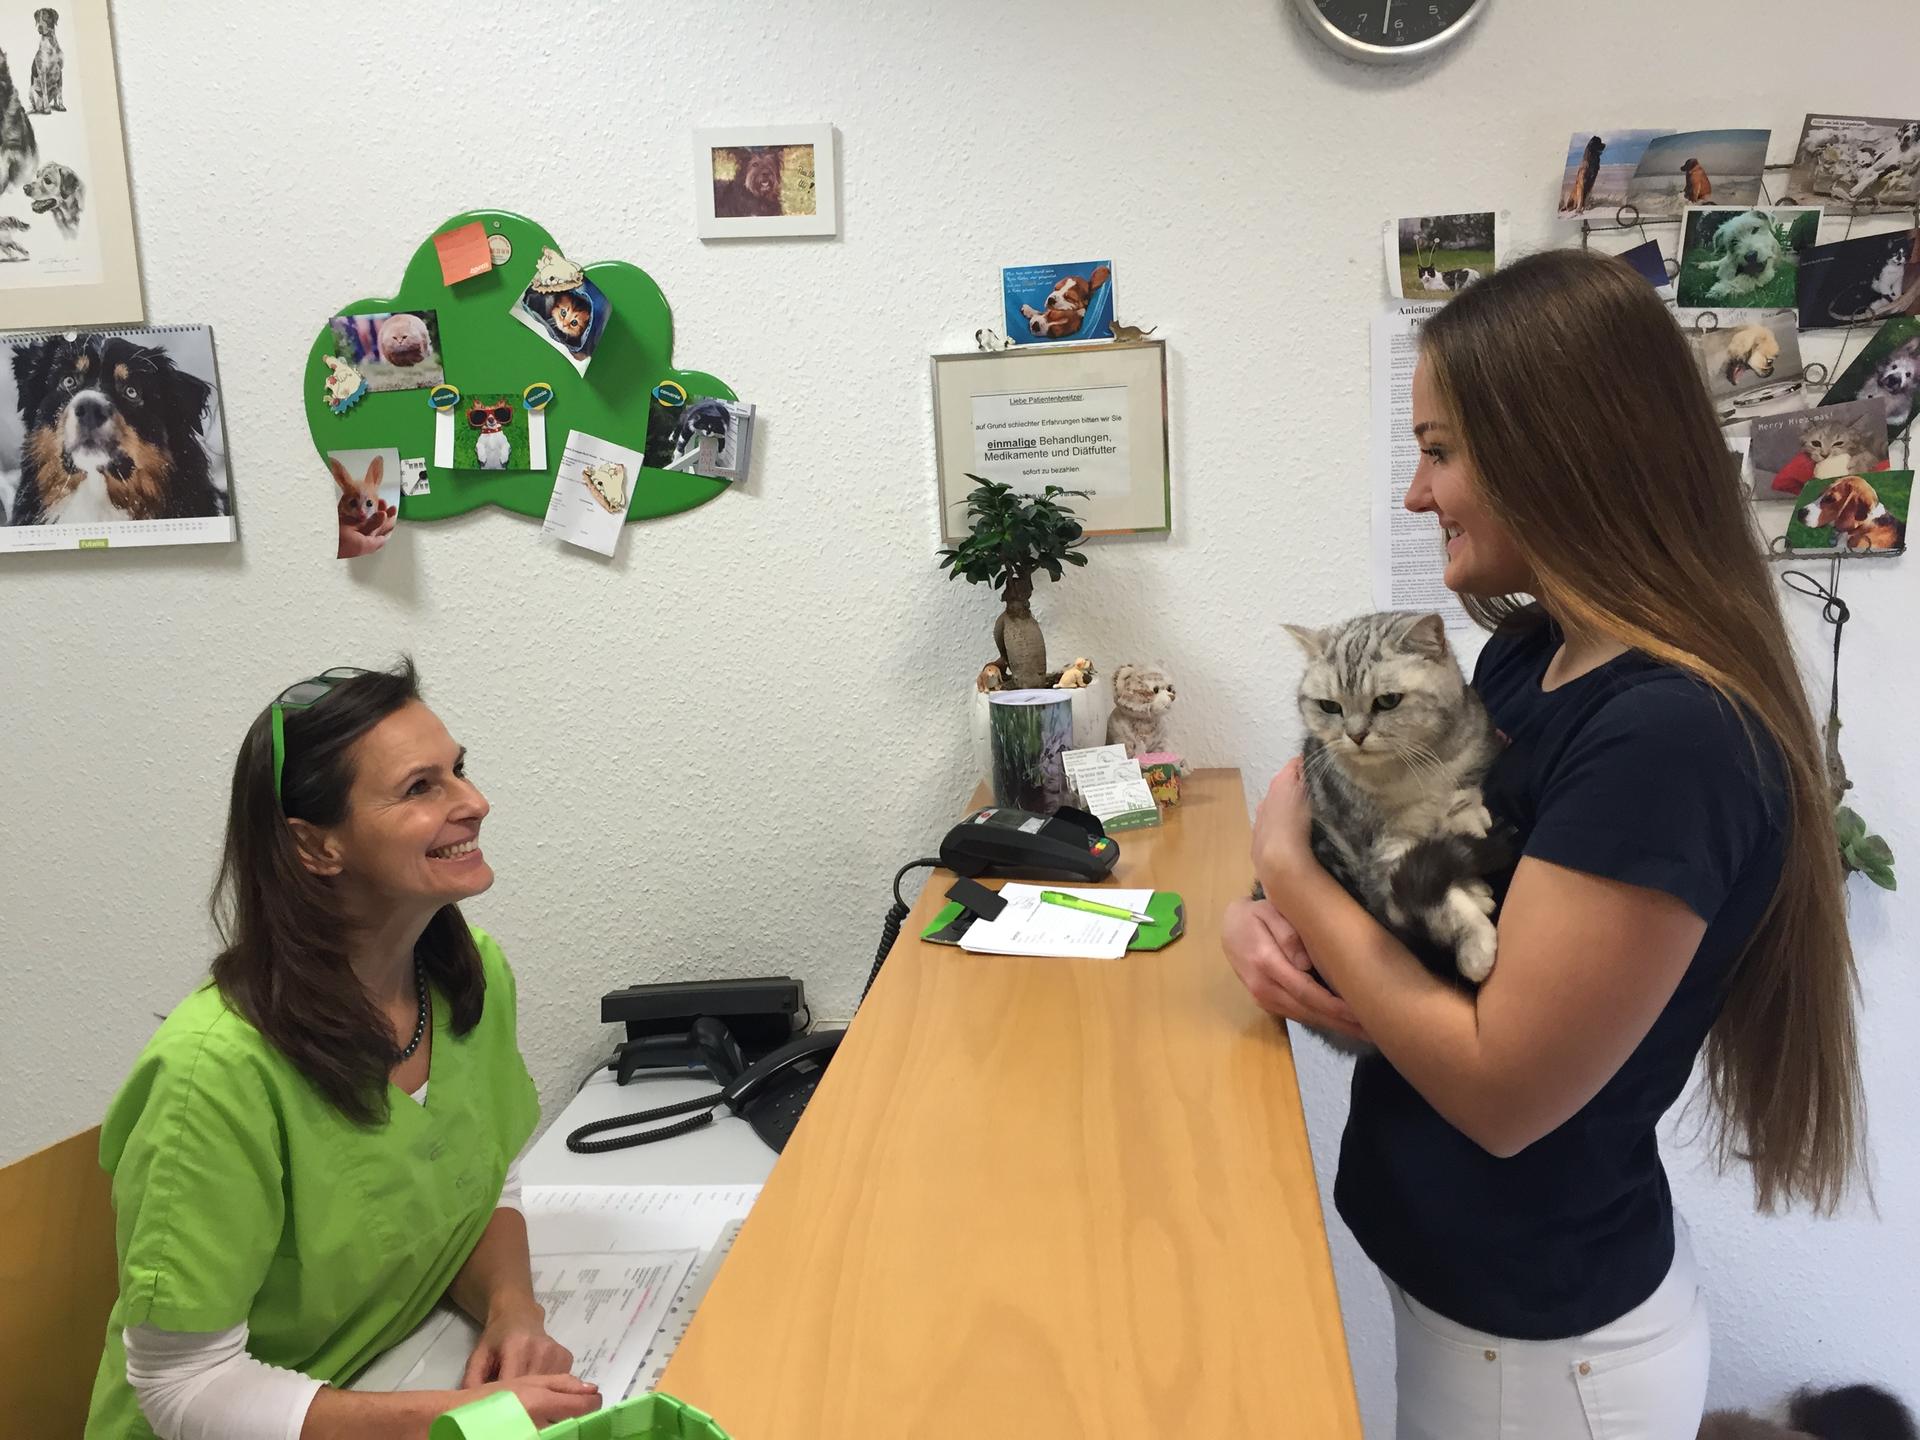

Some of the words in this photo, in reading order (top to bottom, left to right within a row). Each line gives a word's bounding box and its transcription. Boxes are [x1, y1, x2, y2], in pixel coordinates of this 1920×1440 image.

[1428, 5, 1439, 15] 5
[1358, 13, 1368, 23] 7
[1394, 19, 1404, 29] 6
[987, 422, 1007, 430] Grund
[1008, 420, 1040, 429] schlechter
[1041, 418, 1080, 427] Erfahrungen
[1081, 416, 1099, 424] bitten
[1111, 414, 1122, 422] Sie
[1758, 421, 1783, 430] Merry
[987, 437, 1037, 450] einmalige
[1039, 434, 1112, 445] Behandlungen,
[984, 450, 1049, 461] Medikamente
[1051, 447, 1070, 457] und
[1072, 445, 1116, 456] Diätfutter
[1022, 468, 1041, 476] sofort
[1050, 466, 1080, 474] bezahlen
